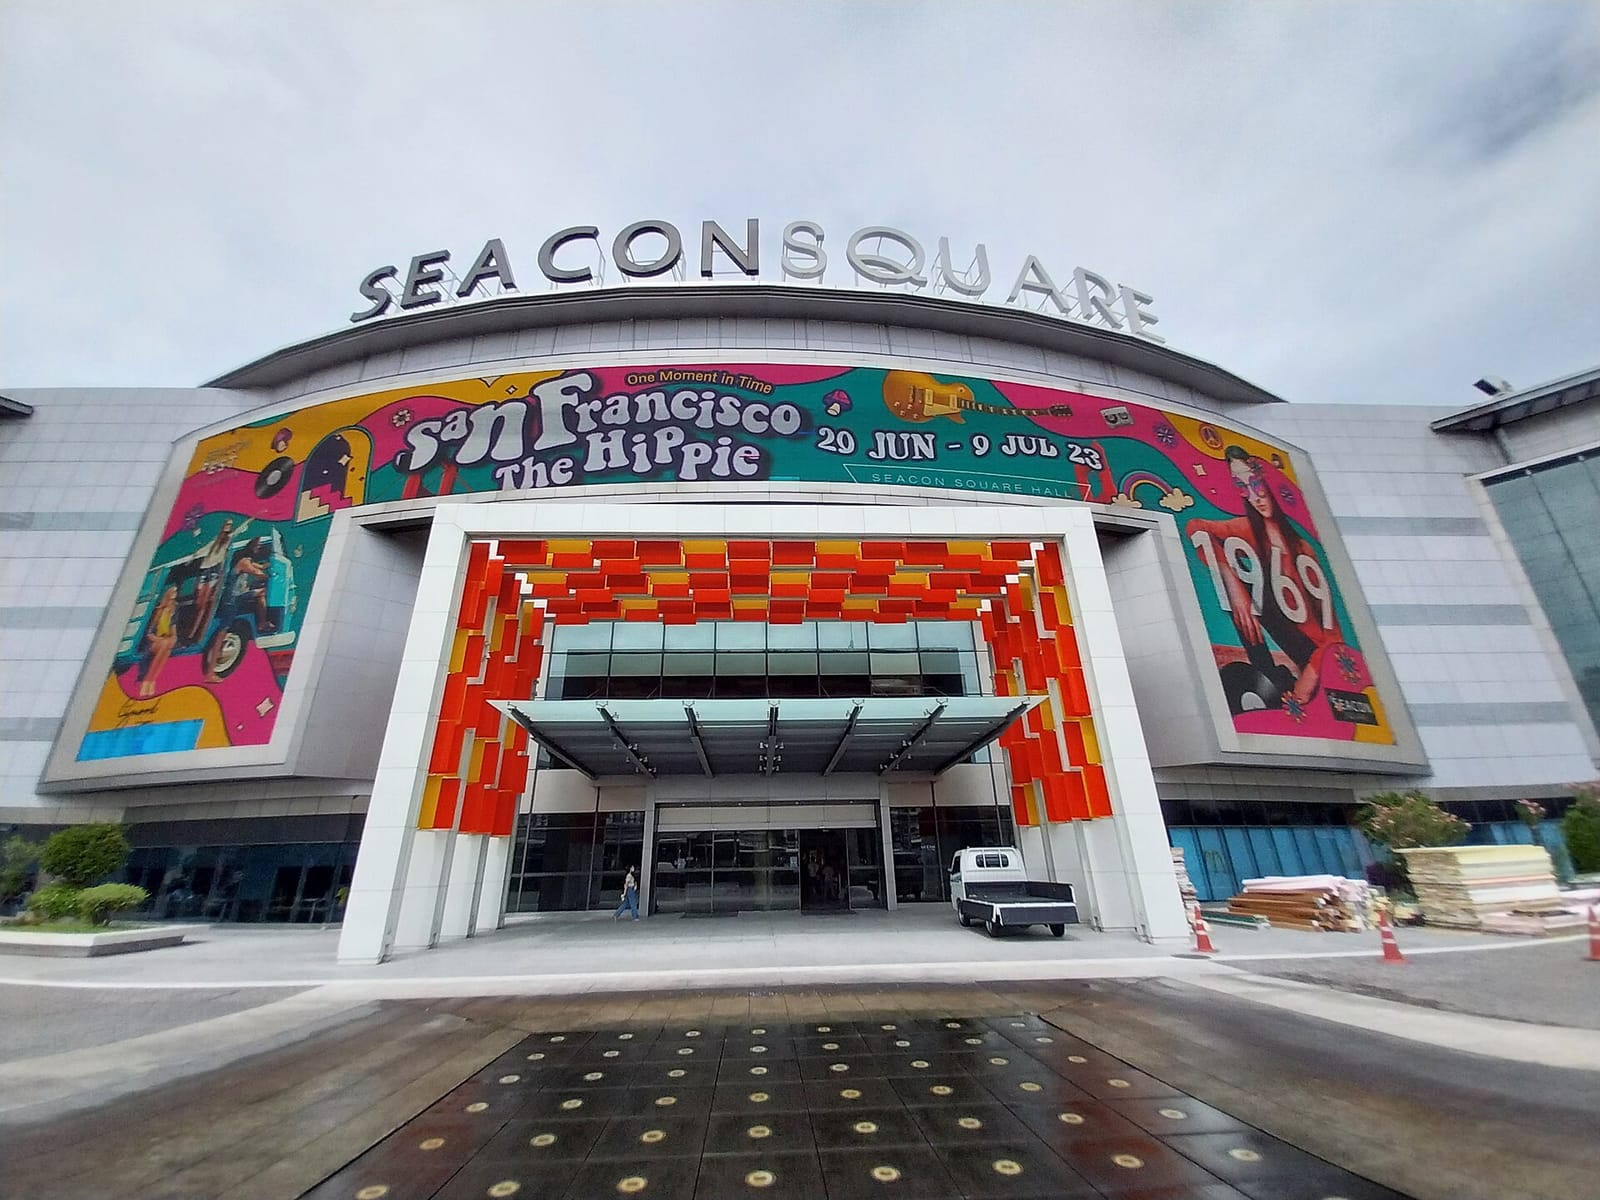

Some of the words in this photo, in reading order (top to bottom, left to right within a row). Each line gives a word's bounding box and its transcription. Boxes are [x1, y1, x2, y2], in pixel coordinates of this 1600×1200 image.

[627, 373, 655, 385] One
[659, 370, 717, 383] Moment
[721, 372, 734, 385] in
[739, 375, 773, 394] Time
[533, 373, 801, 450] Francisco
[817, 427, 855, 454] 20
[868, 432, 936, 460] JUN
[972, 435, 990, 456] 9
[1001, 435, 1058, 457] JUL
[1067, 443, 1102, 470] 23
[496, 456, 574, 491] The
[871, 473, 945, 487] SEACON
[954, 478, 1023, 493] SQUARE
[1031, 485, 1073, 499] HALL
[1190, 530, 1334, 630] 1969
